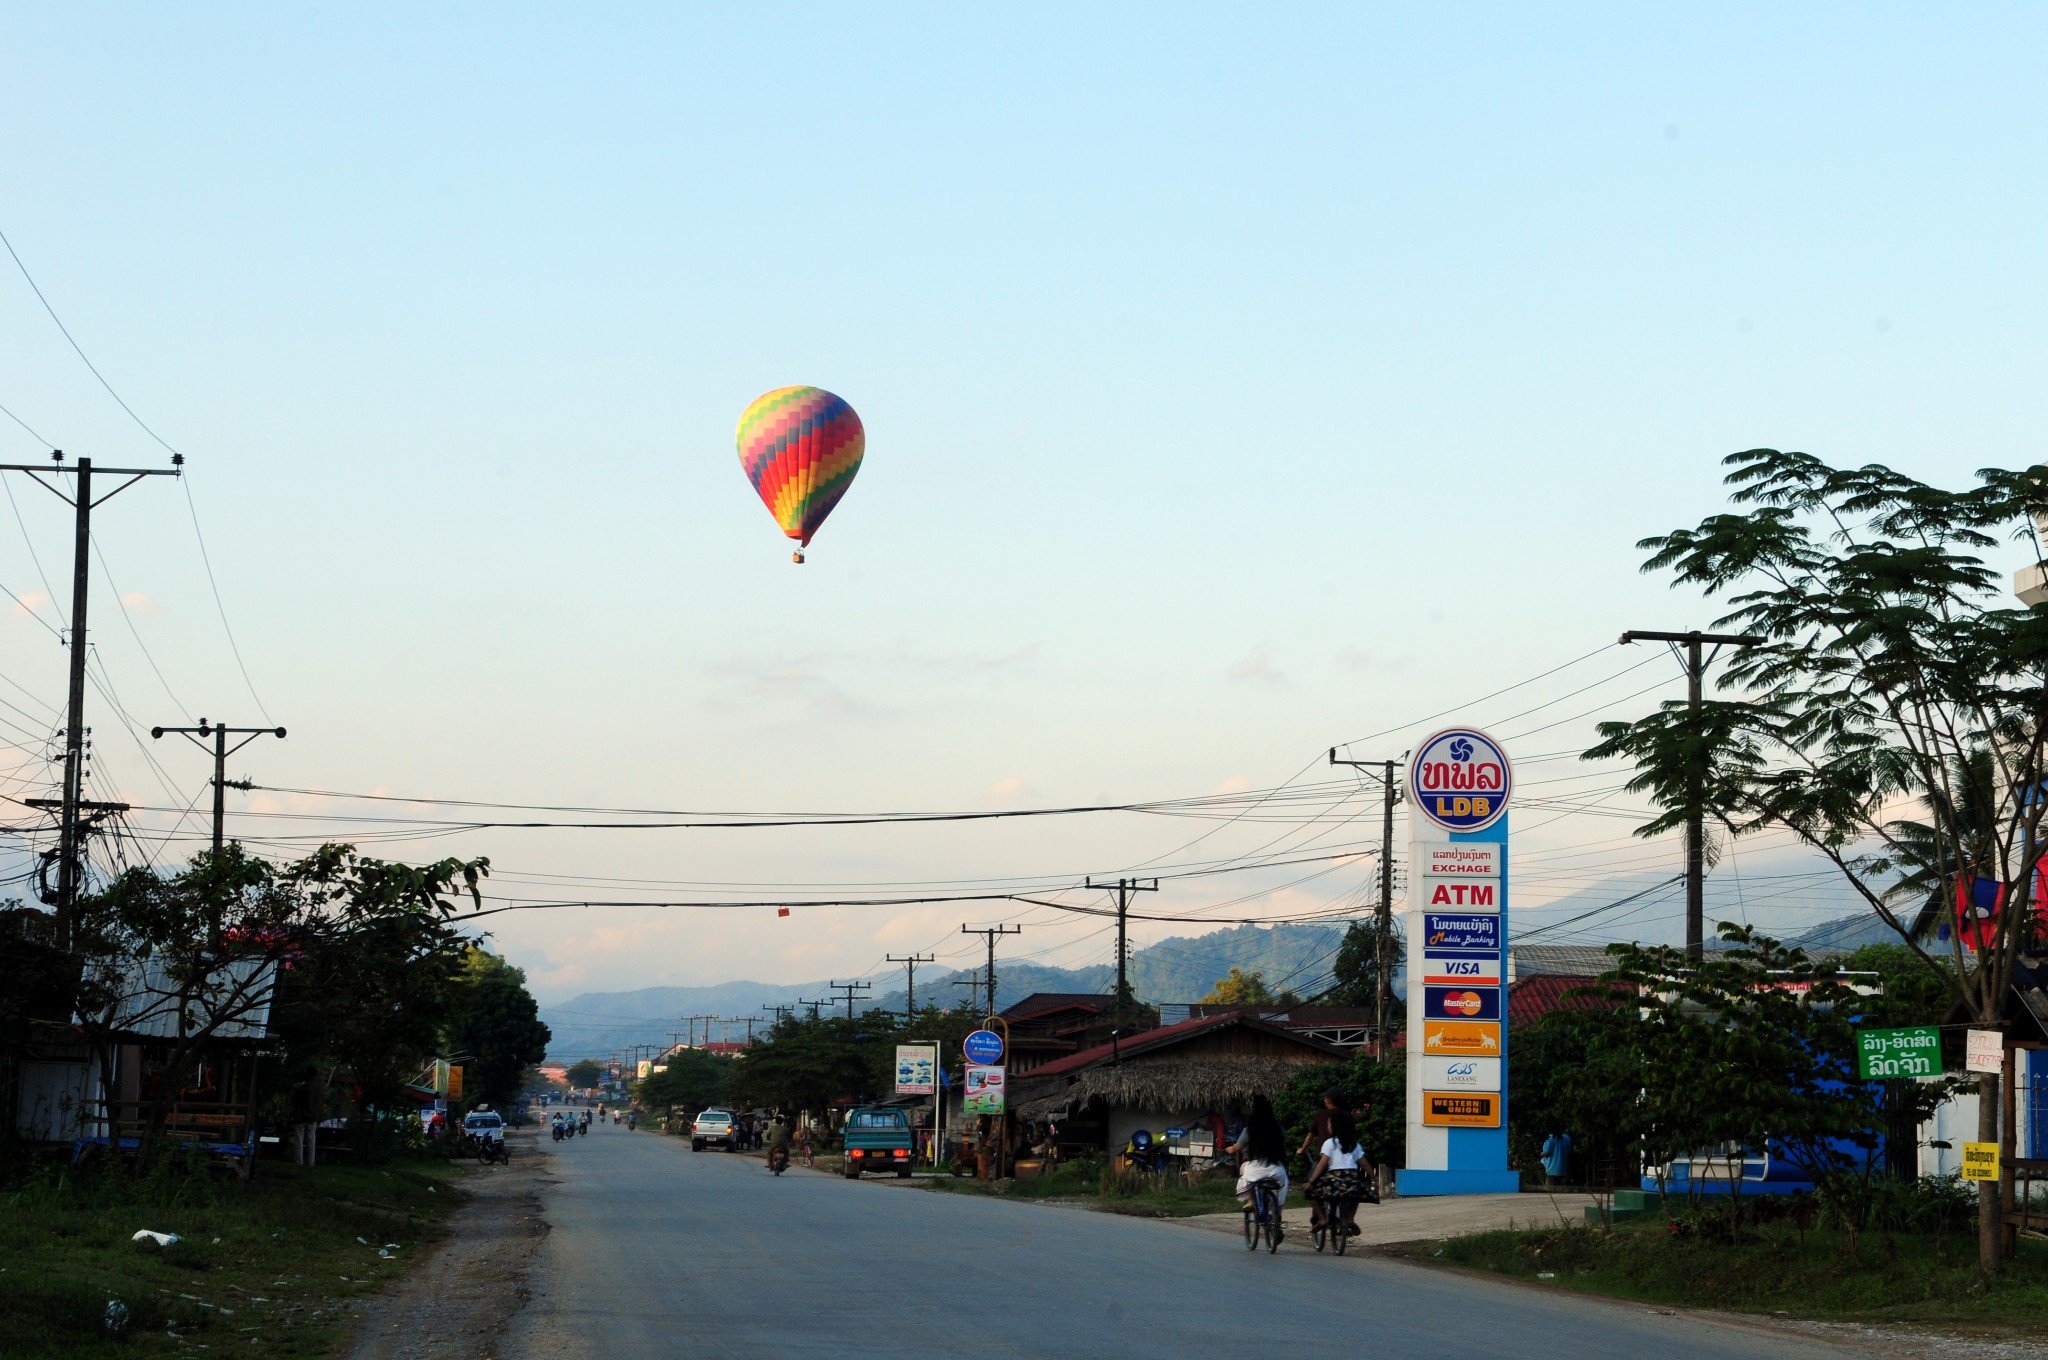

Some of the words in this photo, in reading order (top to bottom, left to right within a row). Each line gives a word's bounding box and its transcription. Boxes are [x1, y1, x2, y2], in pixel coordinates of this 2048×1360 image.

[1436, 797, 1491, 816] LDB
[1432, 864, 1492, 873] EXCHAGE
[1431, 884, 1493, 905] ATM
[1429, 931, 1461, 945] Mobile
[1461, 935, 1495, 947] Banking
[1445, 962, 1480, 975] VISA
[1444, 998, 1481, 1008] MasterCard
[1448, 1106, 1479, 1114] UNION
